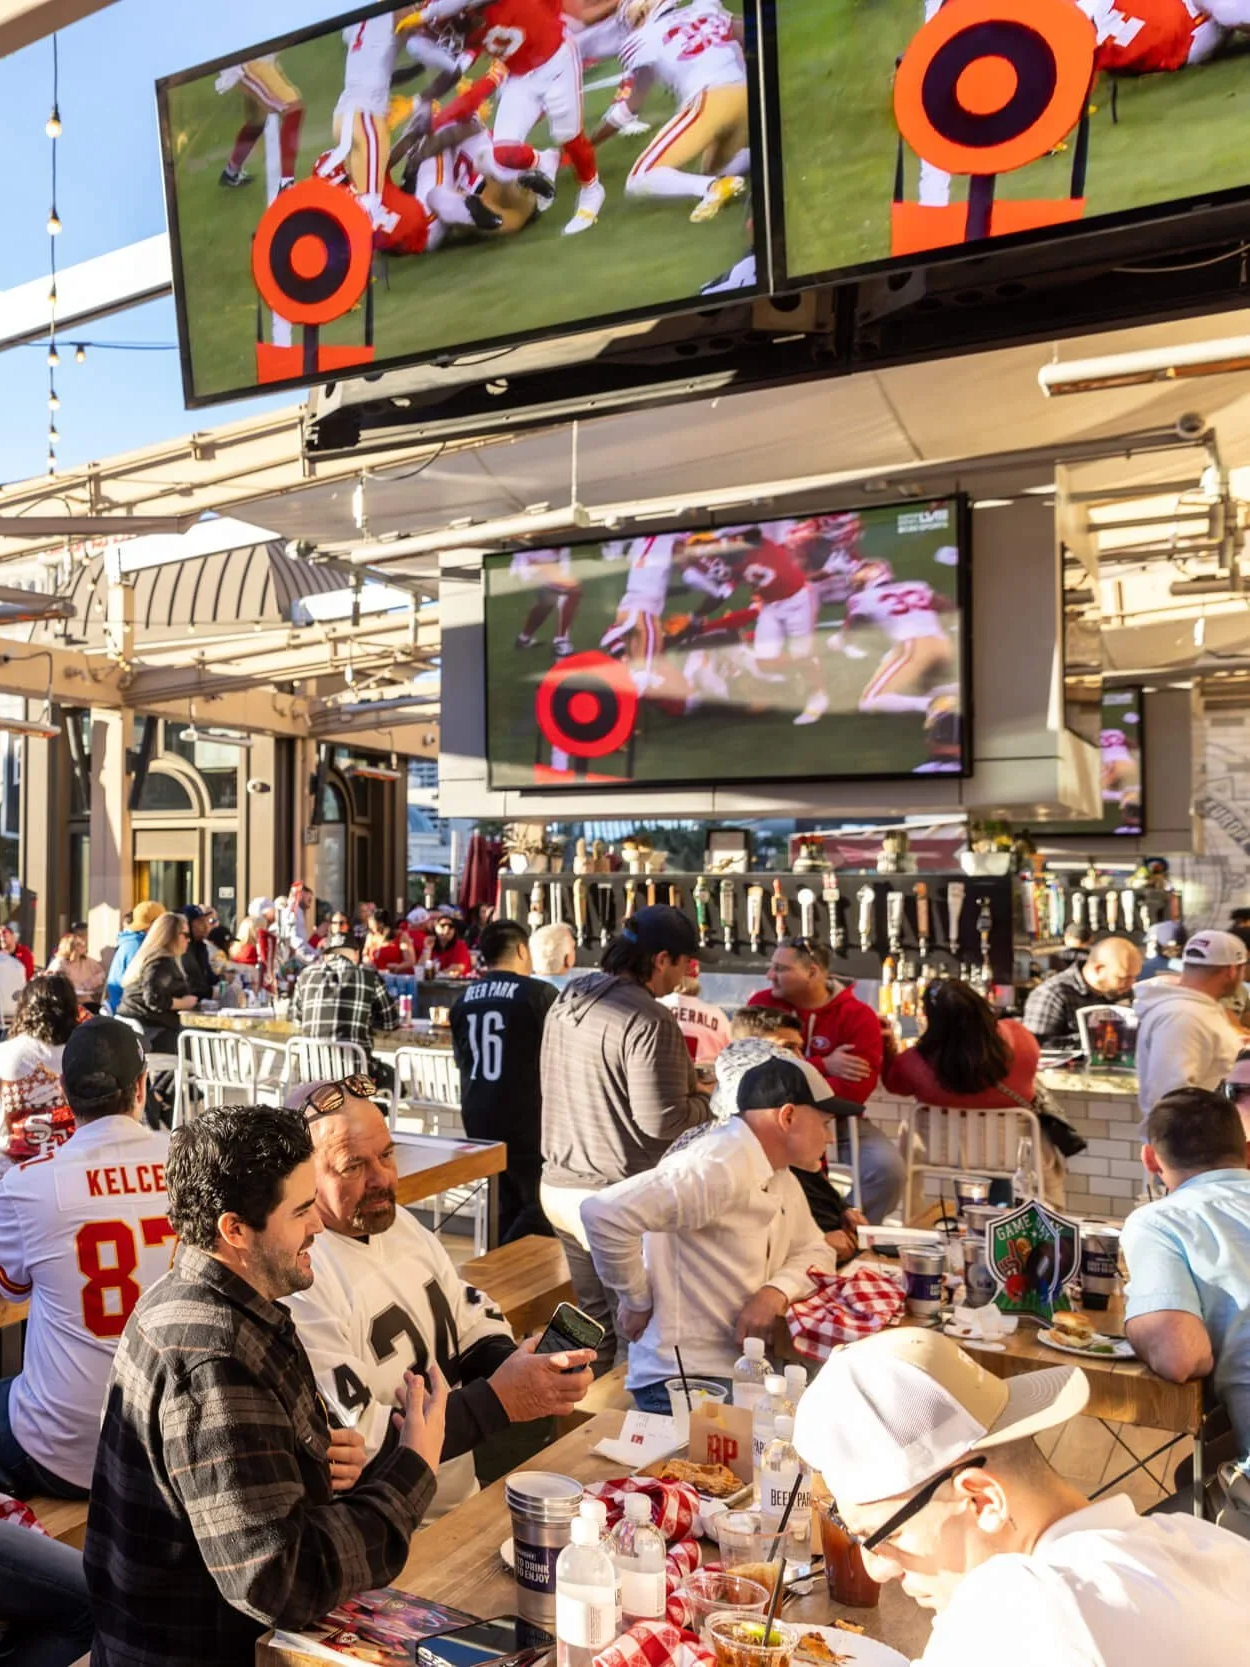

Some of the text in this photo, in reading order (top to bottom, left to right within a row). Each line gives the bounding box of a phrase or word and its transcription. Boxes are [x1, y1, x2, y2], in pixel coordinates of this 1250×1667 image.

[489, 981, 519, 999] PARK
[466, 1010, 505, 1081] 16
[86, 1164, 166, 1197] KELCE
[996, 1214, 1033, 1241] GAME
[524, 1569, 550, 1584] ENJOY
[525, 1560, 549, 1575] DRINK
